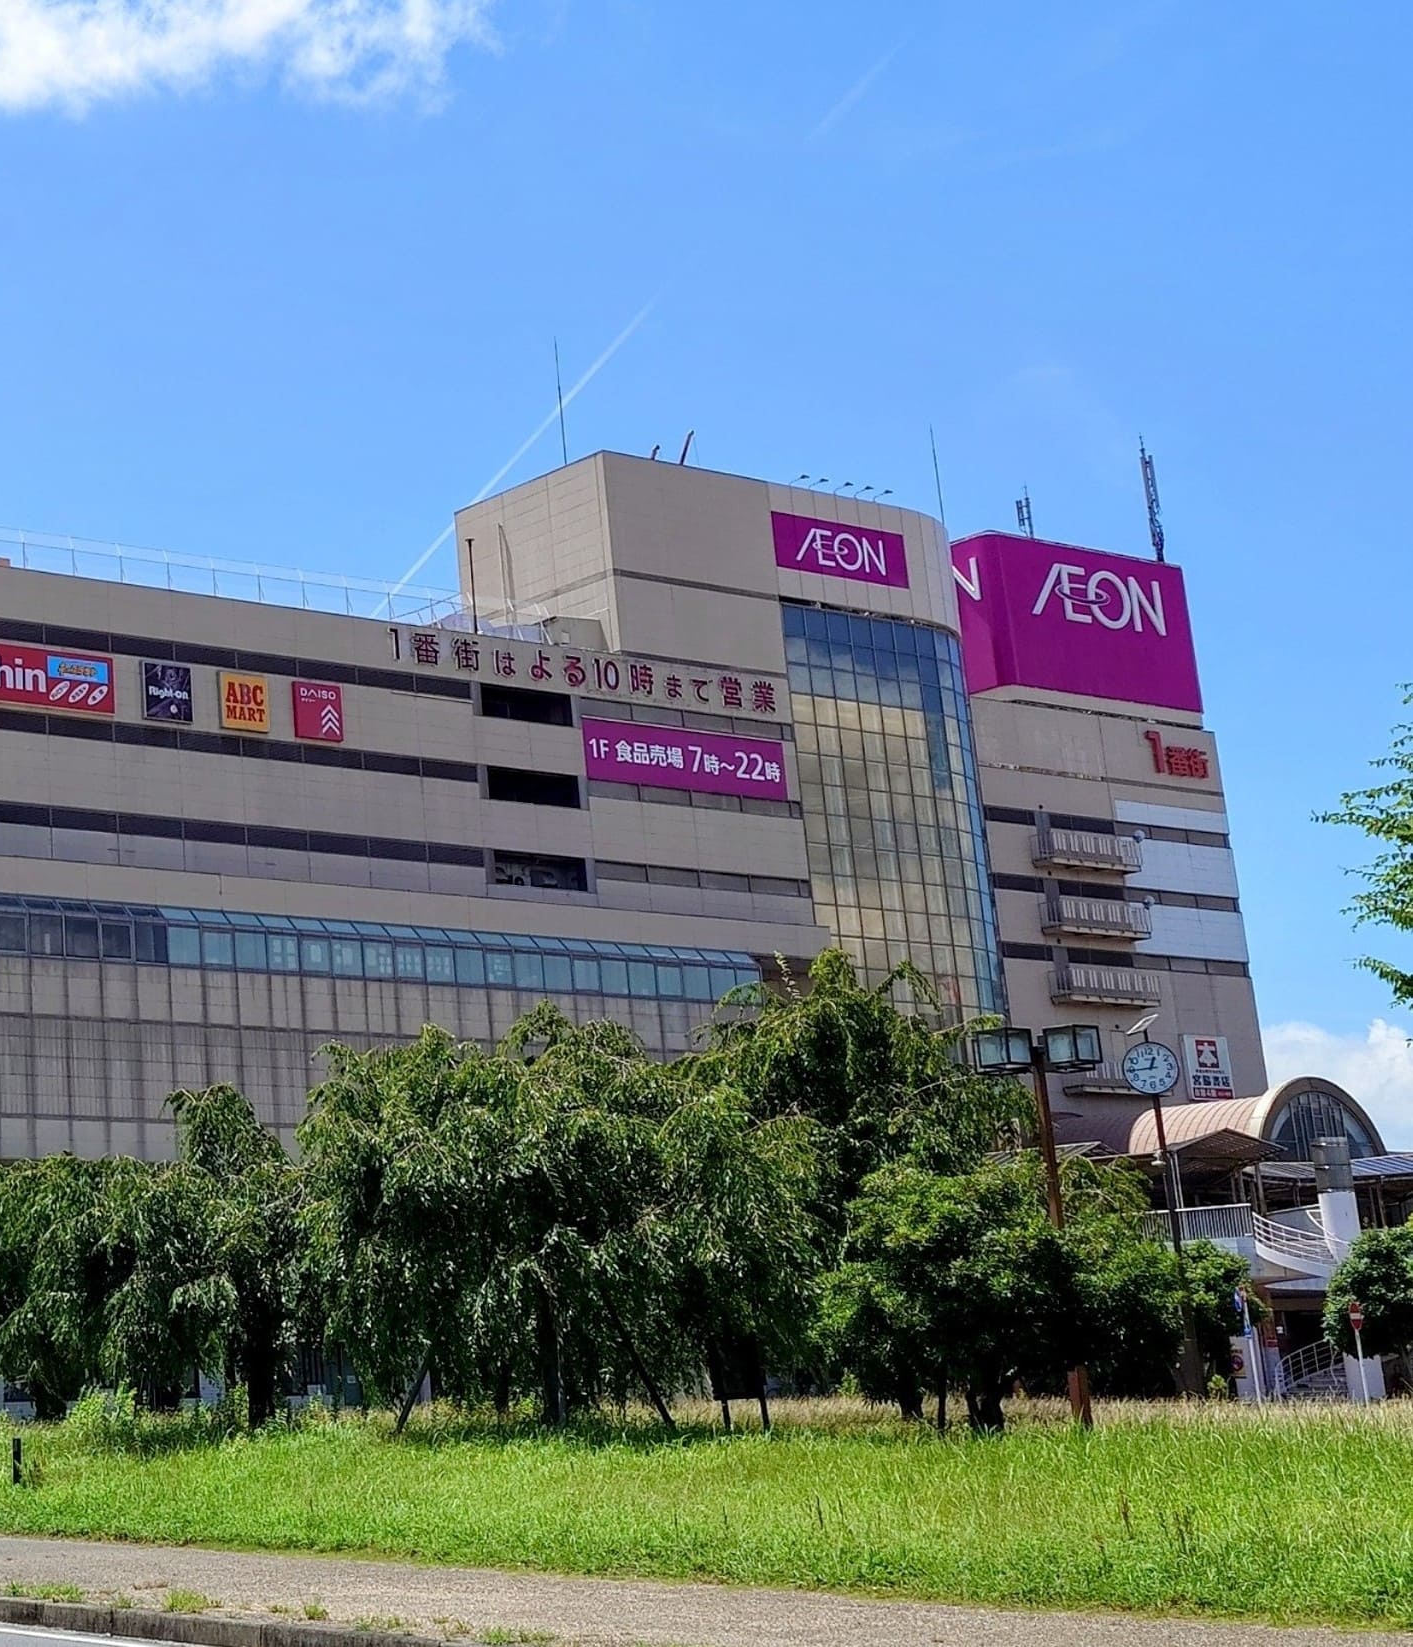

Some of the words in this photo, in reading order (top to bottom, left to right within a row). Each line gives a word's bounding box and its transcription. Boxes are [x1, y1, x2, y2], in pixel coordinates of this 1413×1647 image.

[225, 681, 264, 707] ABC
[300, 687, 336, 700] DAISO
[225, 704, 266, 723] MART
[588, 738, 610, 758] 1F
[615, 741, 684, 769] 食品売場
[1144, 730, 1210, 780] 1番街
[1144, 1047, 1153, 1055] 12
[1150, 1081, 1156, 1089] 6
